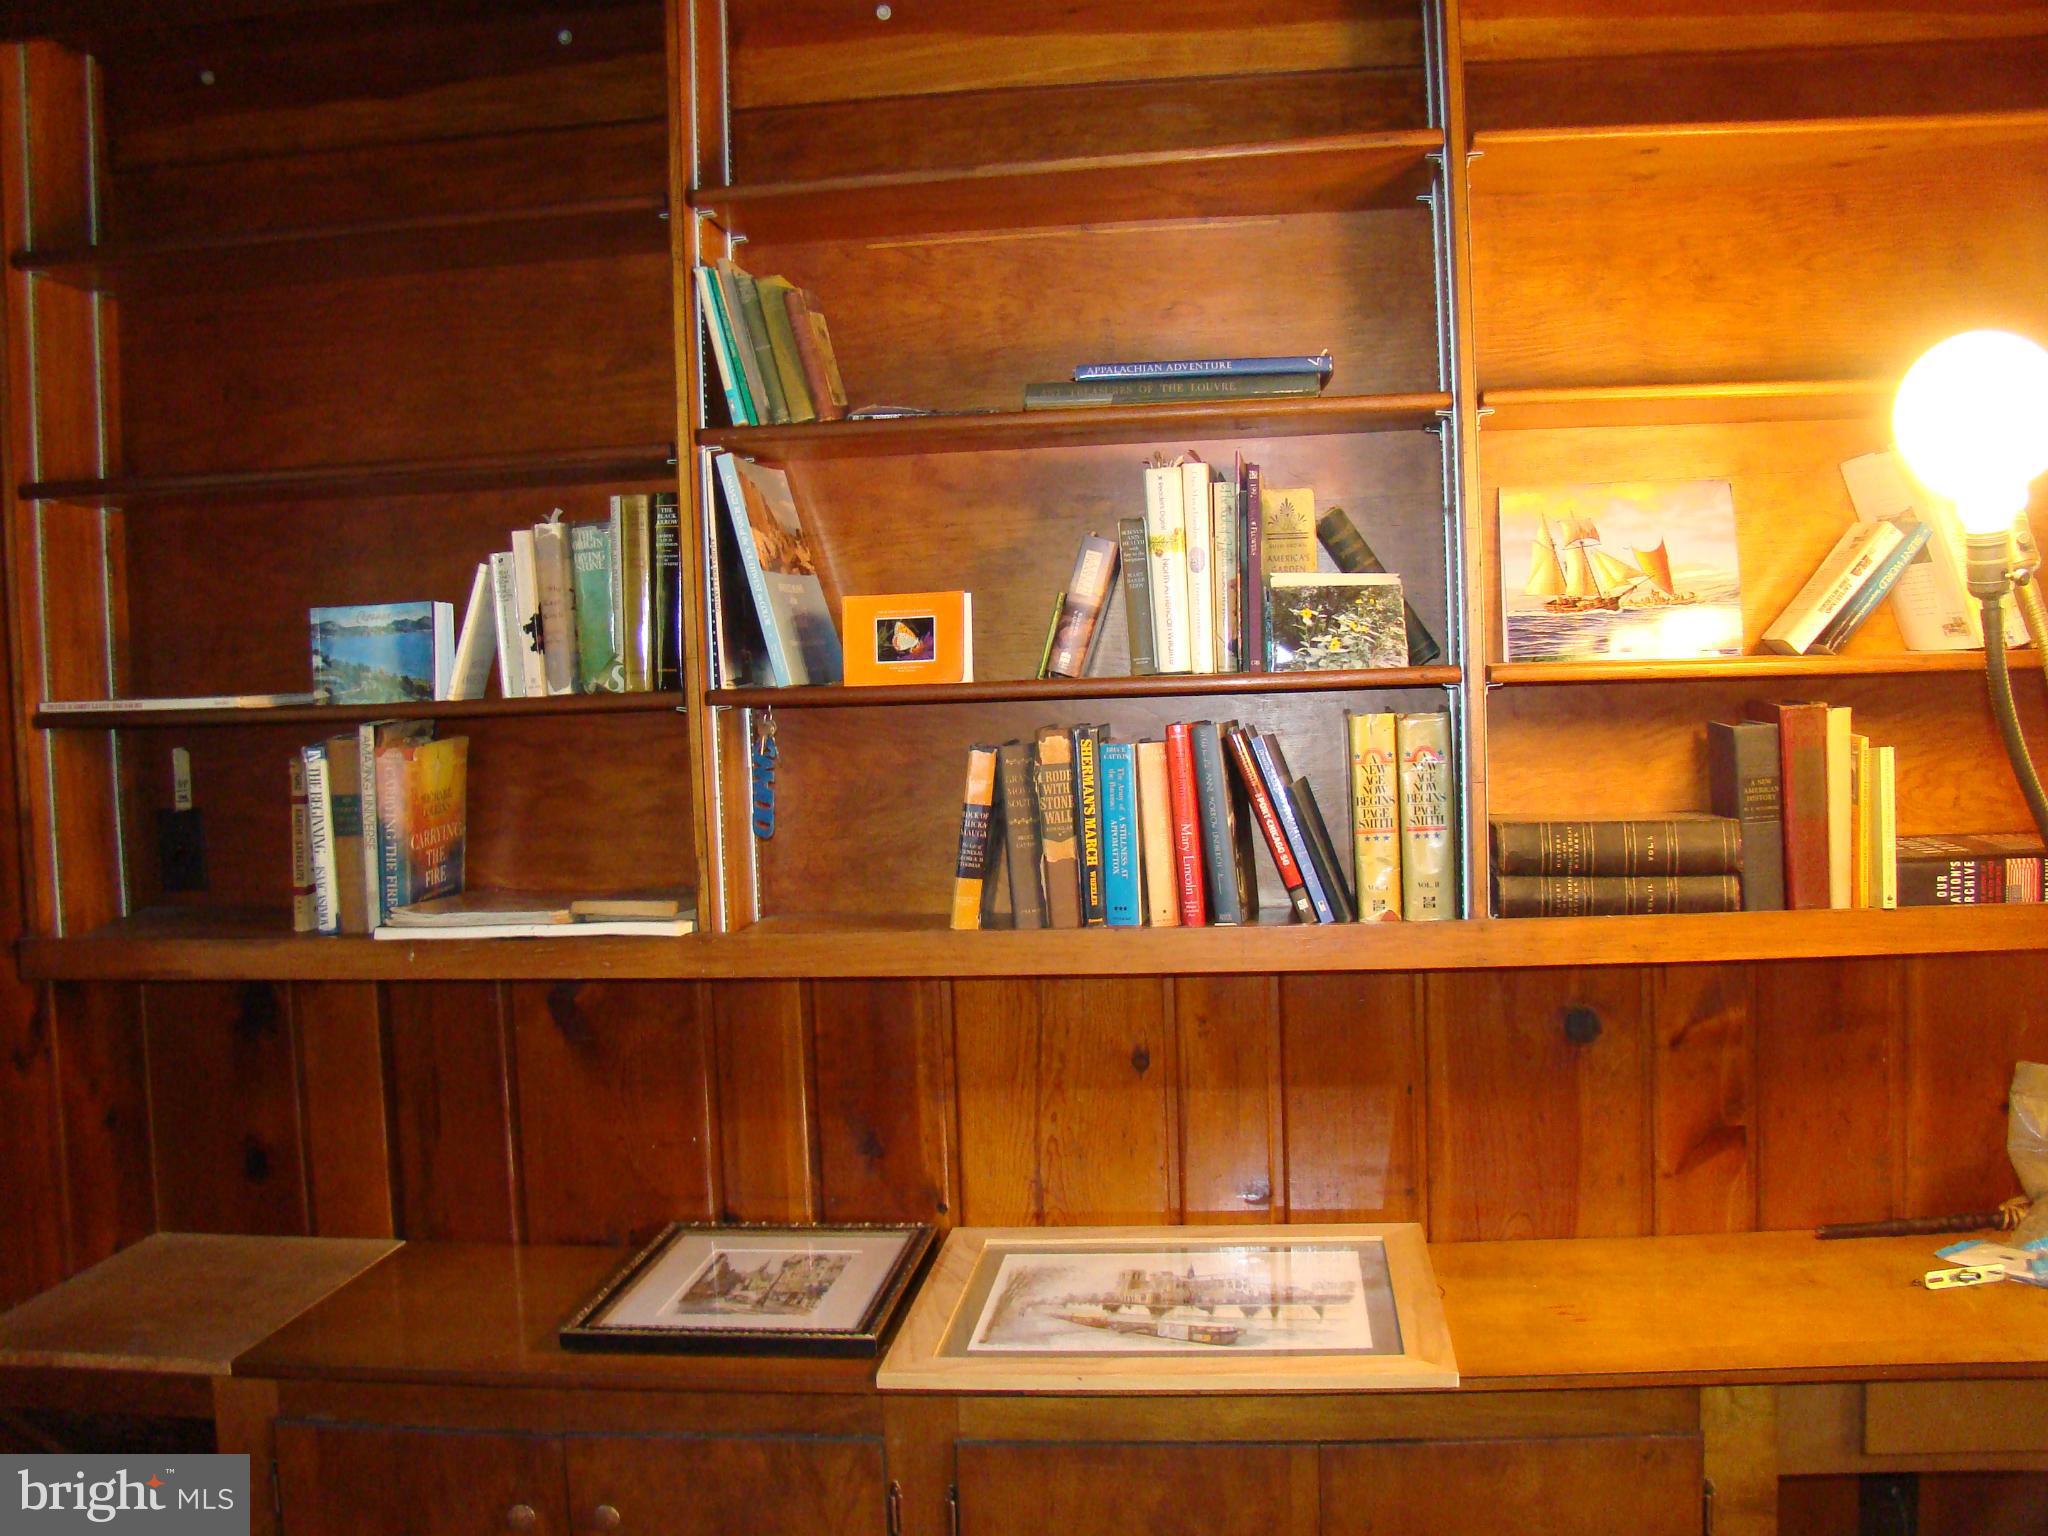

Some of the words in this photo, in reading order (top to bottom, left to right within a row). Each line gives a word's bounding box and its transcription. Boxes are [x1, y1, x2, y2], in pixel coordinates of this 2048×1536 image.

[1087, 363, 1163, 375] APPALACHIAN
[1166, 361, 1232, 372] ADVENTURE
[1161, 383, 1184, 392] THE
[1190, 382, 1237, 392] LOUVRE
[1267, 553, 1310, 562] AMERICA'S
[1271, 565, 1306, 573] GARDEN
[745, 547, 763, 593] SOUTHWEST
[759, 601, 771, 626] COLOR
[362, 735, 371, 790] AMAZING
[1370, 755, 1377, 764] A
[1117, 767, 1125, 781] The
[1361, 764, 1385, 775] NEW
[1412, 762, 1437, 772] NEW
[307, 767, 321, 787] THE
[1006, 774, 1029, 784] GRAN
[1045, 769, 1072, 782] RODE
[1080, 738, 1096, 816] SHERMAN'S
[1365, 775, 1384, 786] AGE
[1416, 772, 1437, 783] AGE
[1043, 782, 1071, 795] WITH
[1362, 785, 1387, 796] NOW
[1413, 782, 1437, 793] NOW
[1743, 785, 1779, 794] AMERICAN
[384, 766, 398, 841] CARRYING
[1040, 795, 1073, 810] STONE
[1356, 796, 1395, 807] BEGINS
[1407, 793, 1447, 803] BEGINS
[1744, 794, 1776, 802] HISTORY
[1045, 810, 1074, 824] WALL
[1363, 808, 1390, 818] PAGE
[1413, 805, 1441, 816] PAGE
[308, 791, 327, 854] BEGINNING
[364, 793, 374, 850] UNIVERSE
[962, 820, 988, 829] HICKA
[1358, 817, 1394, 828] SMITH
[1409, 815, 1444, 827] SMITH
[411, 822, 463, 850] CARRYING
[1177, 822, 1193, 852] Mary
[1256, 796, 1270, 819] PORT
[1264, 818, 1285, 854] CHICAGO
[1279, 853, 1290, 866] 50
[1084, 817, 1098, 866] MARCH
[1110, 820, 1120, 875] APPOMATTOX
[1119, 823, 1128, 867] STILLNESS
[385, 844, 398, 872] THE
[426, 846, 446, 867] THE
[314, 866, 326, 892] ISAAC
[425, 866, 447, 888] FIRE
[1121, 868, 1128, 878] AT
[1182, 855, 1196, 895] Lincoln
[1089, 870, 1098, 906] WHEELER
[1936, 875, 1948, 898] OUR
[1949, 861, 1962, 903] ATION'S
[1964, 861, 1976, 903] RCHIVE
[386, 875, 399, 908] FIRE
[316, 895, 329, 926] ASIMOV
